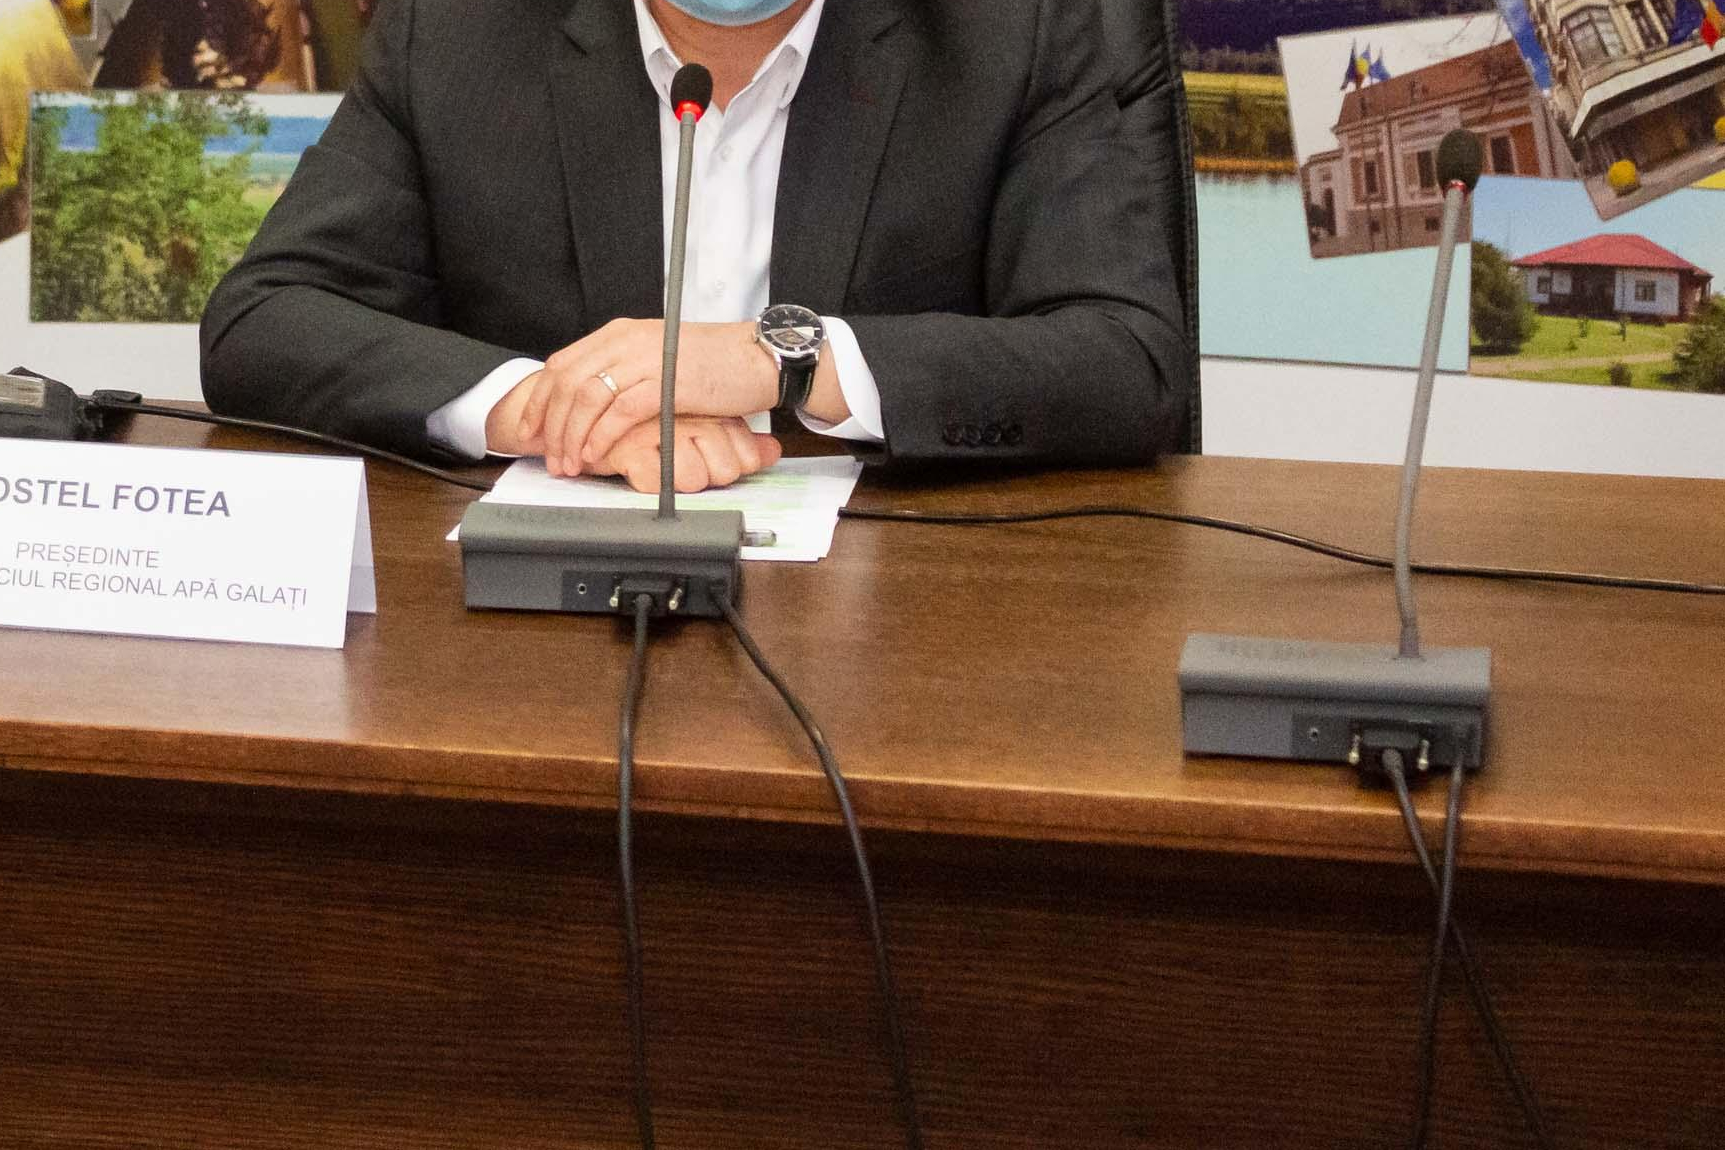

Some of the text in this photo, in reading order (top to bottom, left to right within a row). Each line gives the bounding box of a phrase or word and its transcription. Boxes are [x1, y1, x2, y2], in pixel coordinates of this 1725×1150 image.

[112, 484, 231, 517] FOTEA
[51, 571, 168, 597] REGIONAL
[173, 578, 219, 601] APĂ
